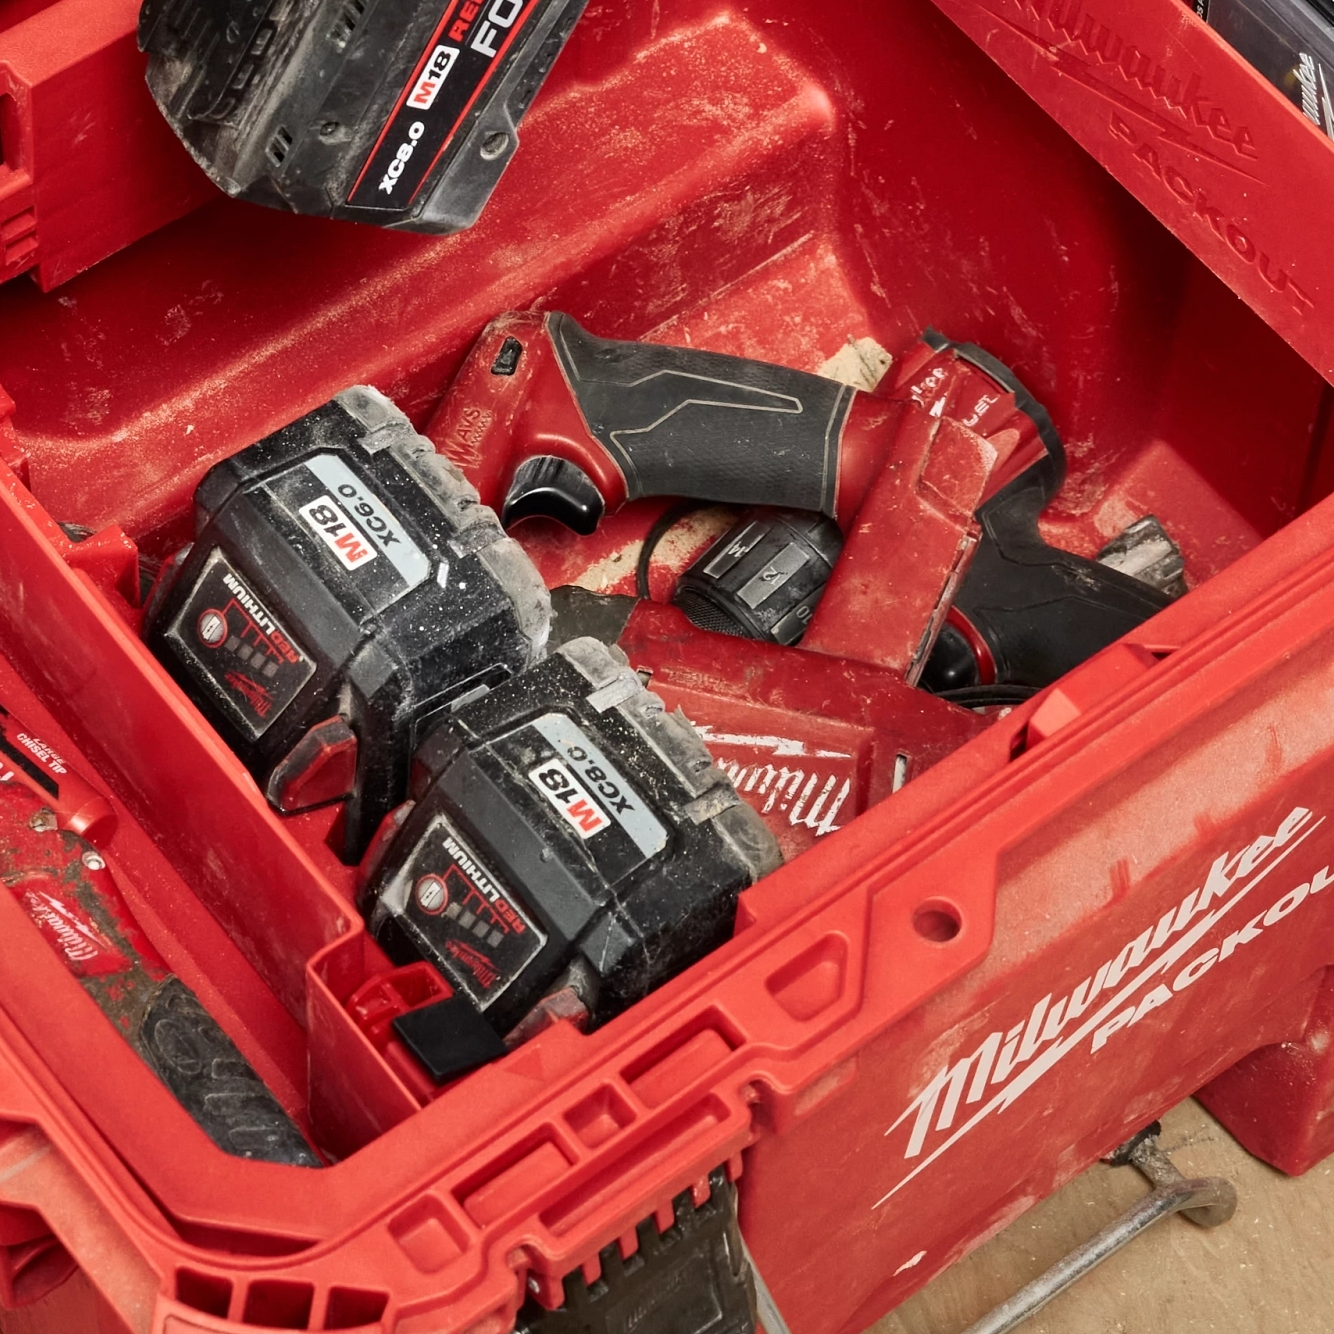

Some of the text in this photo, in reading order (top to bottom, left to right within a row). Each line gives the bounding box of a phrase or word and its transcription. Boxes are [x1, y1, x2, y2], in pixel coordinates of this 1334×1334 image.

[378, 49, 454, 195] XC8.0 M18
[1108, 112, 1315, 317] PACKOUT
[309, 504, 369, 563] M18
[337, 483, 402, 547] XC6.0
[761, 566, 781, 586] 12
[222, 573, 300, 664] REDLITHIUM
[16, 732, 68, 776] CHISEL TIP
[567, 746, 636, 815] XC8.0
[538, 768, 603, 833] M18
[442, 836, 526, 935] REDLITHIUM
[883, 805, 1314, 1160] Milwaukee
